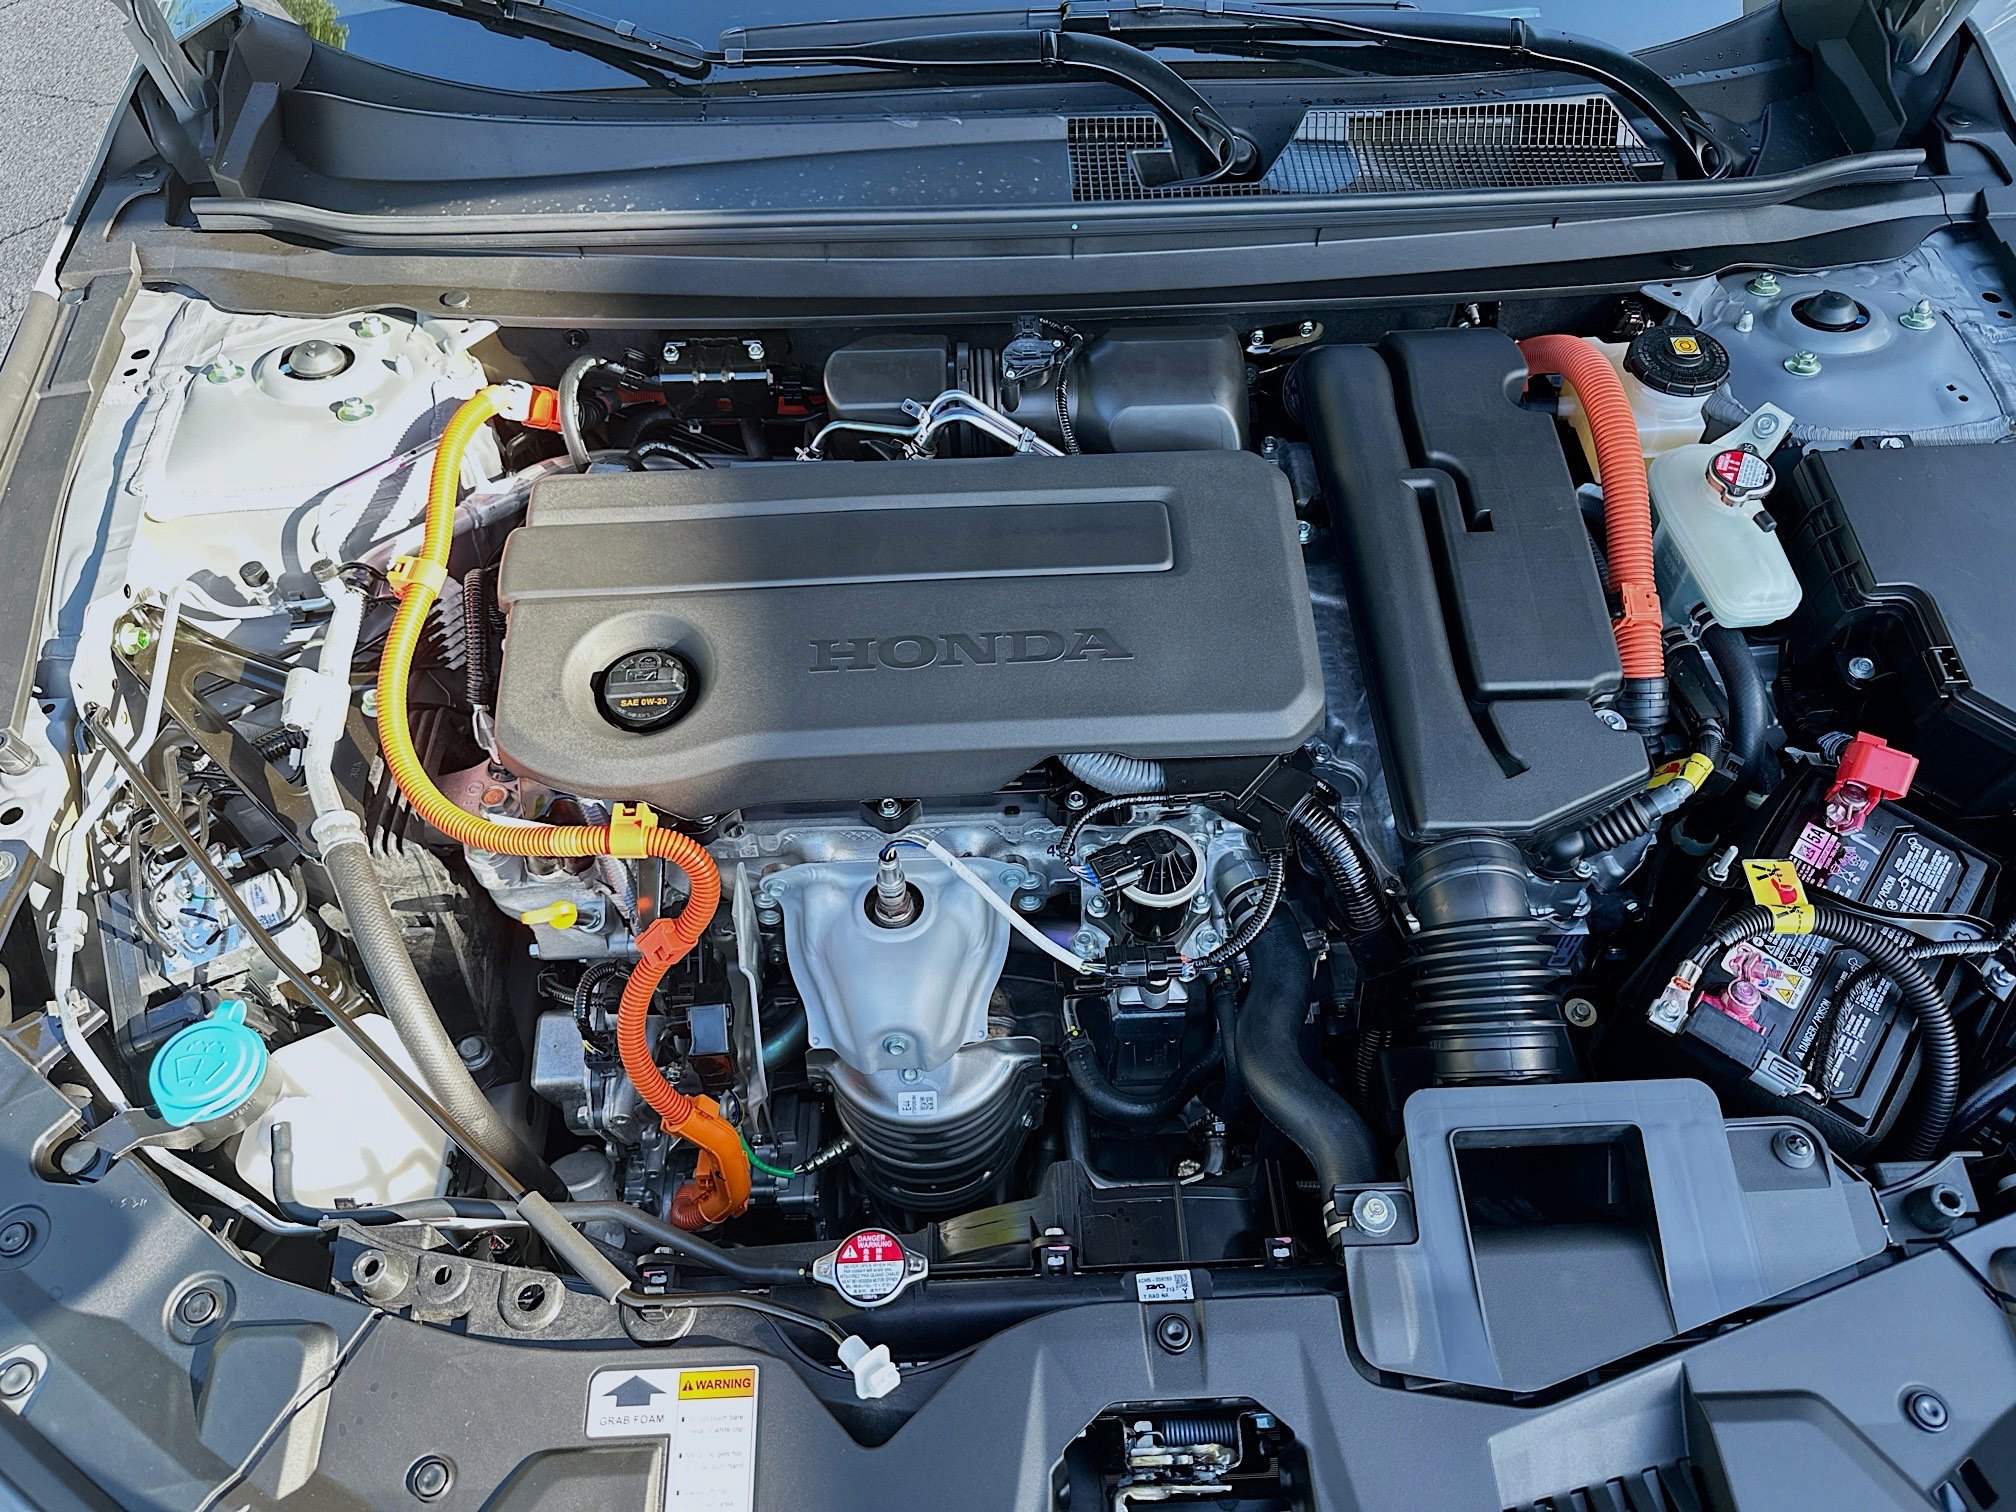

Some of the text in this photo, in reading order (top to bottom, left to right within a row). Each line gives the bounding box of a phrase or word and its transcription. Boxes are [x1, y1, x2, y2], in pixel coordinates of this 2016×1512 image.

[808, 628, 1134, 673] HONDA
[620, 697, 668, 707] SAE 0W-20
[1805, 826, 1825, 845] 5A
[857, 1234, 886, 1242] DANGER
[695, 1378, 751, 1390] WARNING
[600, 1414, 665, 1426] GRAB FOAM
